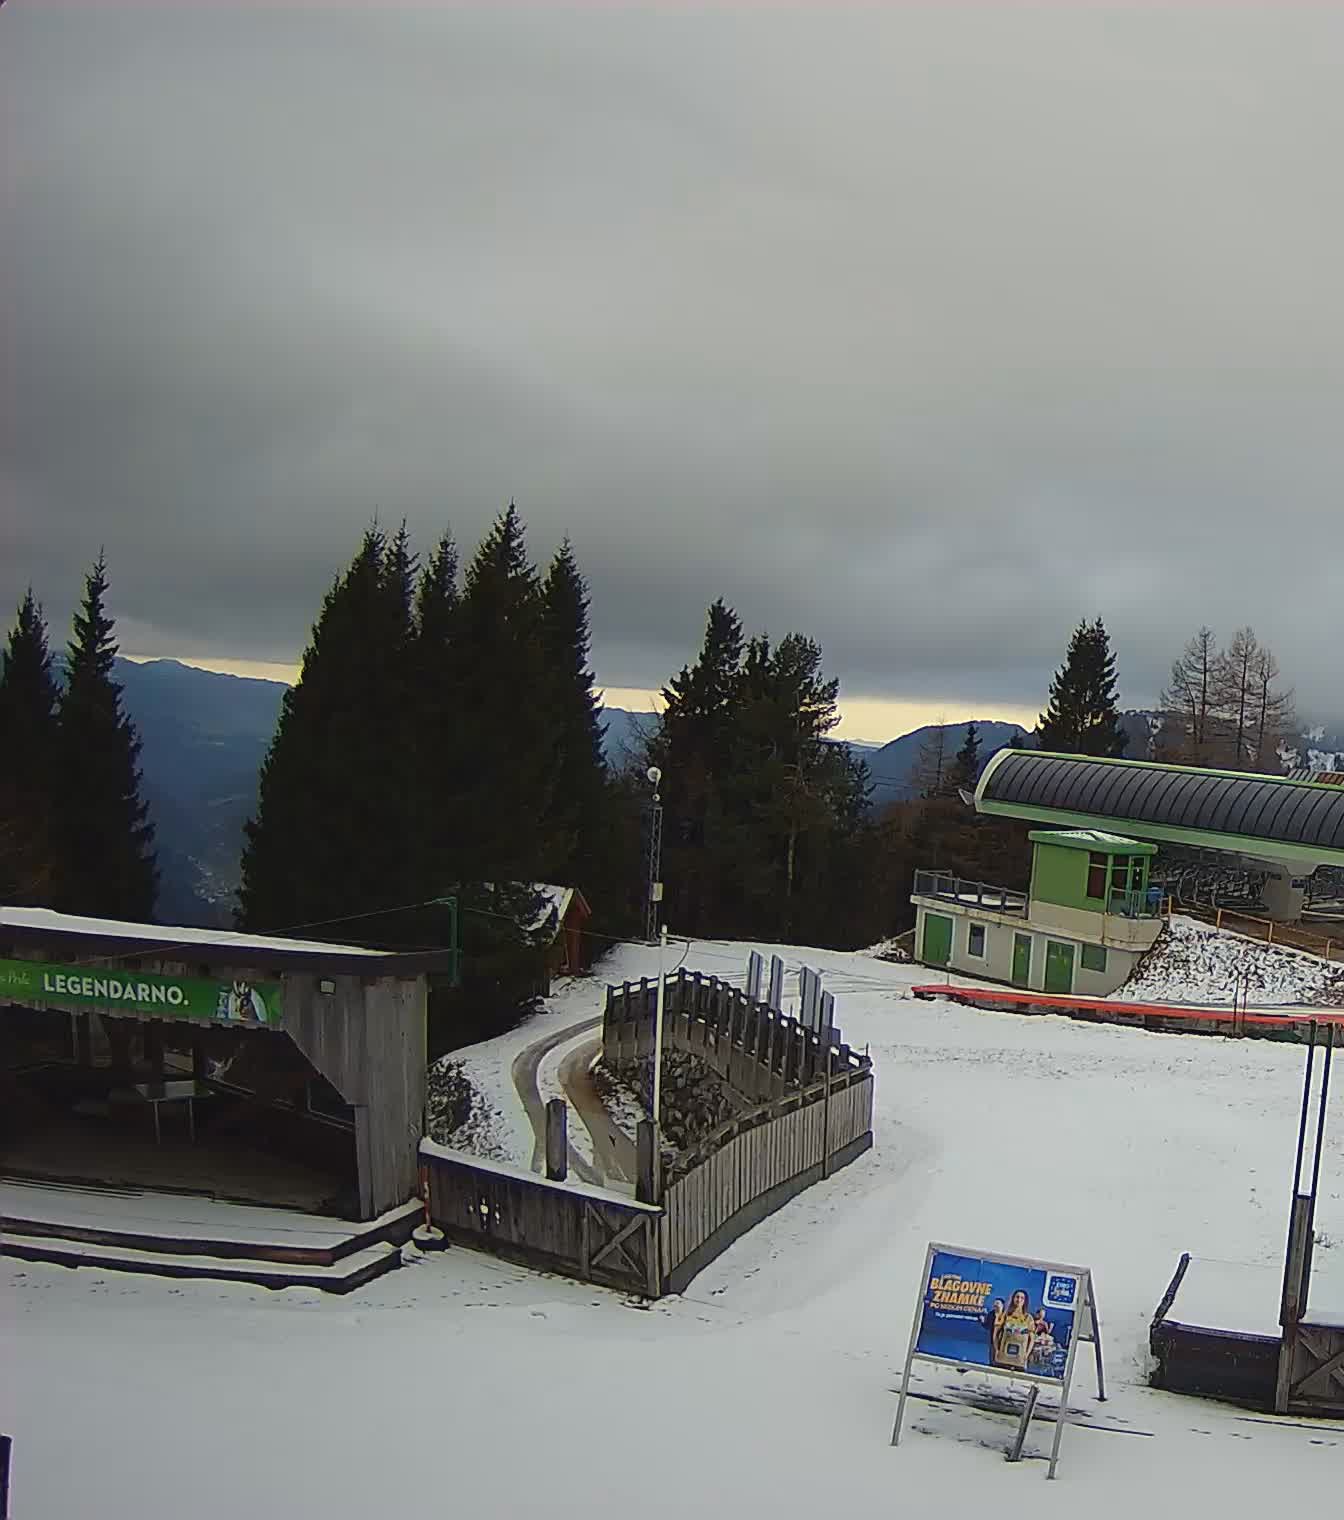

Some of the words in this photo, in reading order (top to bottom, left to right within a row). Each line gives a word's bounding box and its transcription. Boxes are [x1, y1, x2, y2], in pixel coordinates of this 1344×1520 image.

[43, 973, 189, 1006] LEGENDARNO.
[930, 1277, 993, 1296] BLAGOVNE
[932, 1290, 985, 1307] ZNAMKE
